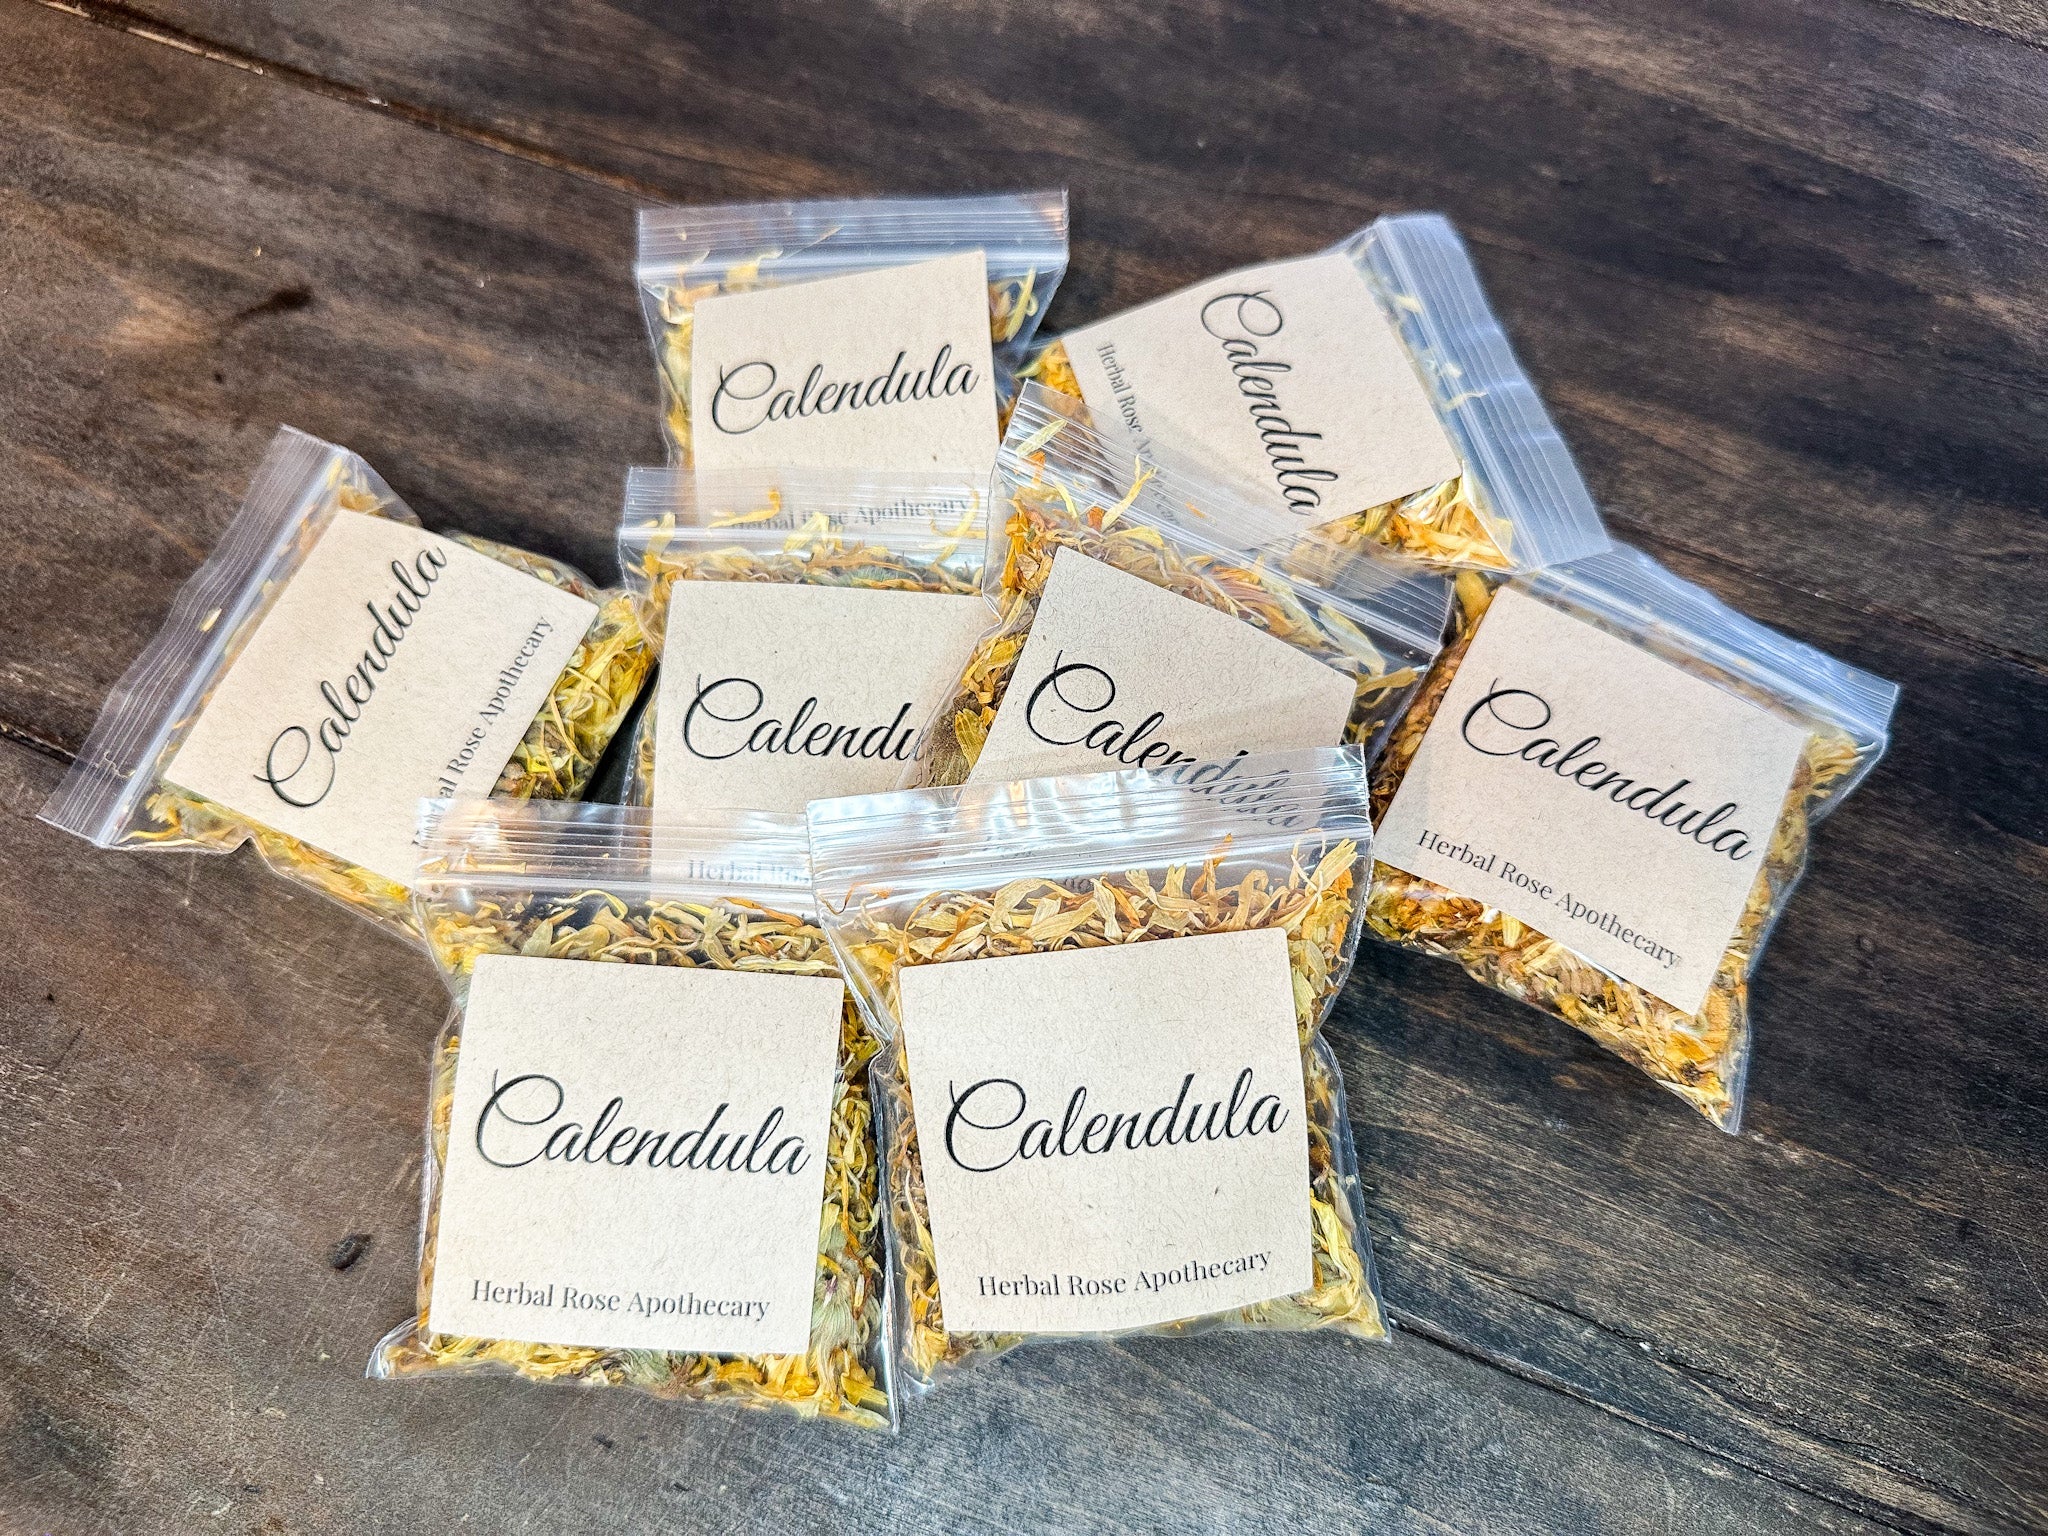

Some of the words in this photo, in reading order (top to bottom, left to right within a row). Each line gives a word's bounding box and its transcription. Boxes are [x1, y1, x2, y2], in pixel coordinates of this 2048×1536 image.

[711, 344, 980, 435] Calendula
[1096, 343, 1132, 395] Herbal
[1200, 290, 1339, 516] Calendula
[253, 544, 448, 808] Calendula
[446, 727, 487, 775] Rose
[479, 616, 554, 726] Apothecary
[1460, 677, 1753, 863] Calendula
[1416, 828, 1497, 874] Herbal
[1498, 860, 1553, 900] Rose
[1555, 892, 1683, 969] Apothecary
[475, 1068, 813, 1176] Calendula
[944, 1066, 1290, 1174] Calendula
[471, 1279, 554, 1308] Herbal
[561, 1286, 621, 1312] Rose
[626, 1291, 771, 1322] Apothecary
[977, 1273, 1061, 1297] Herbal
[1067, 1275, 1127, 1296] Rose
[1133, 1250, 1272, 1293] Apothecary
